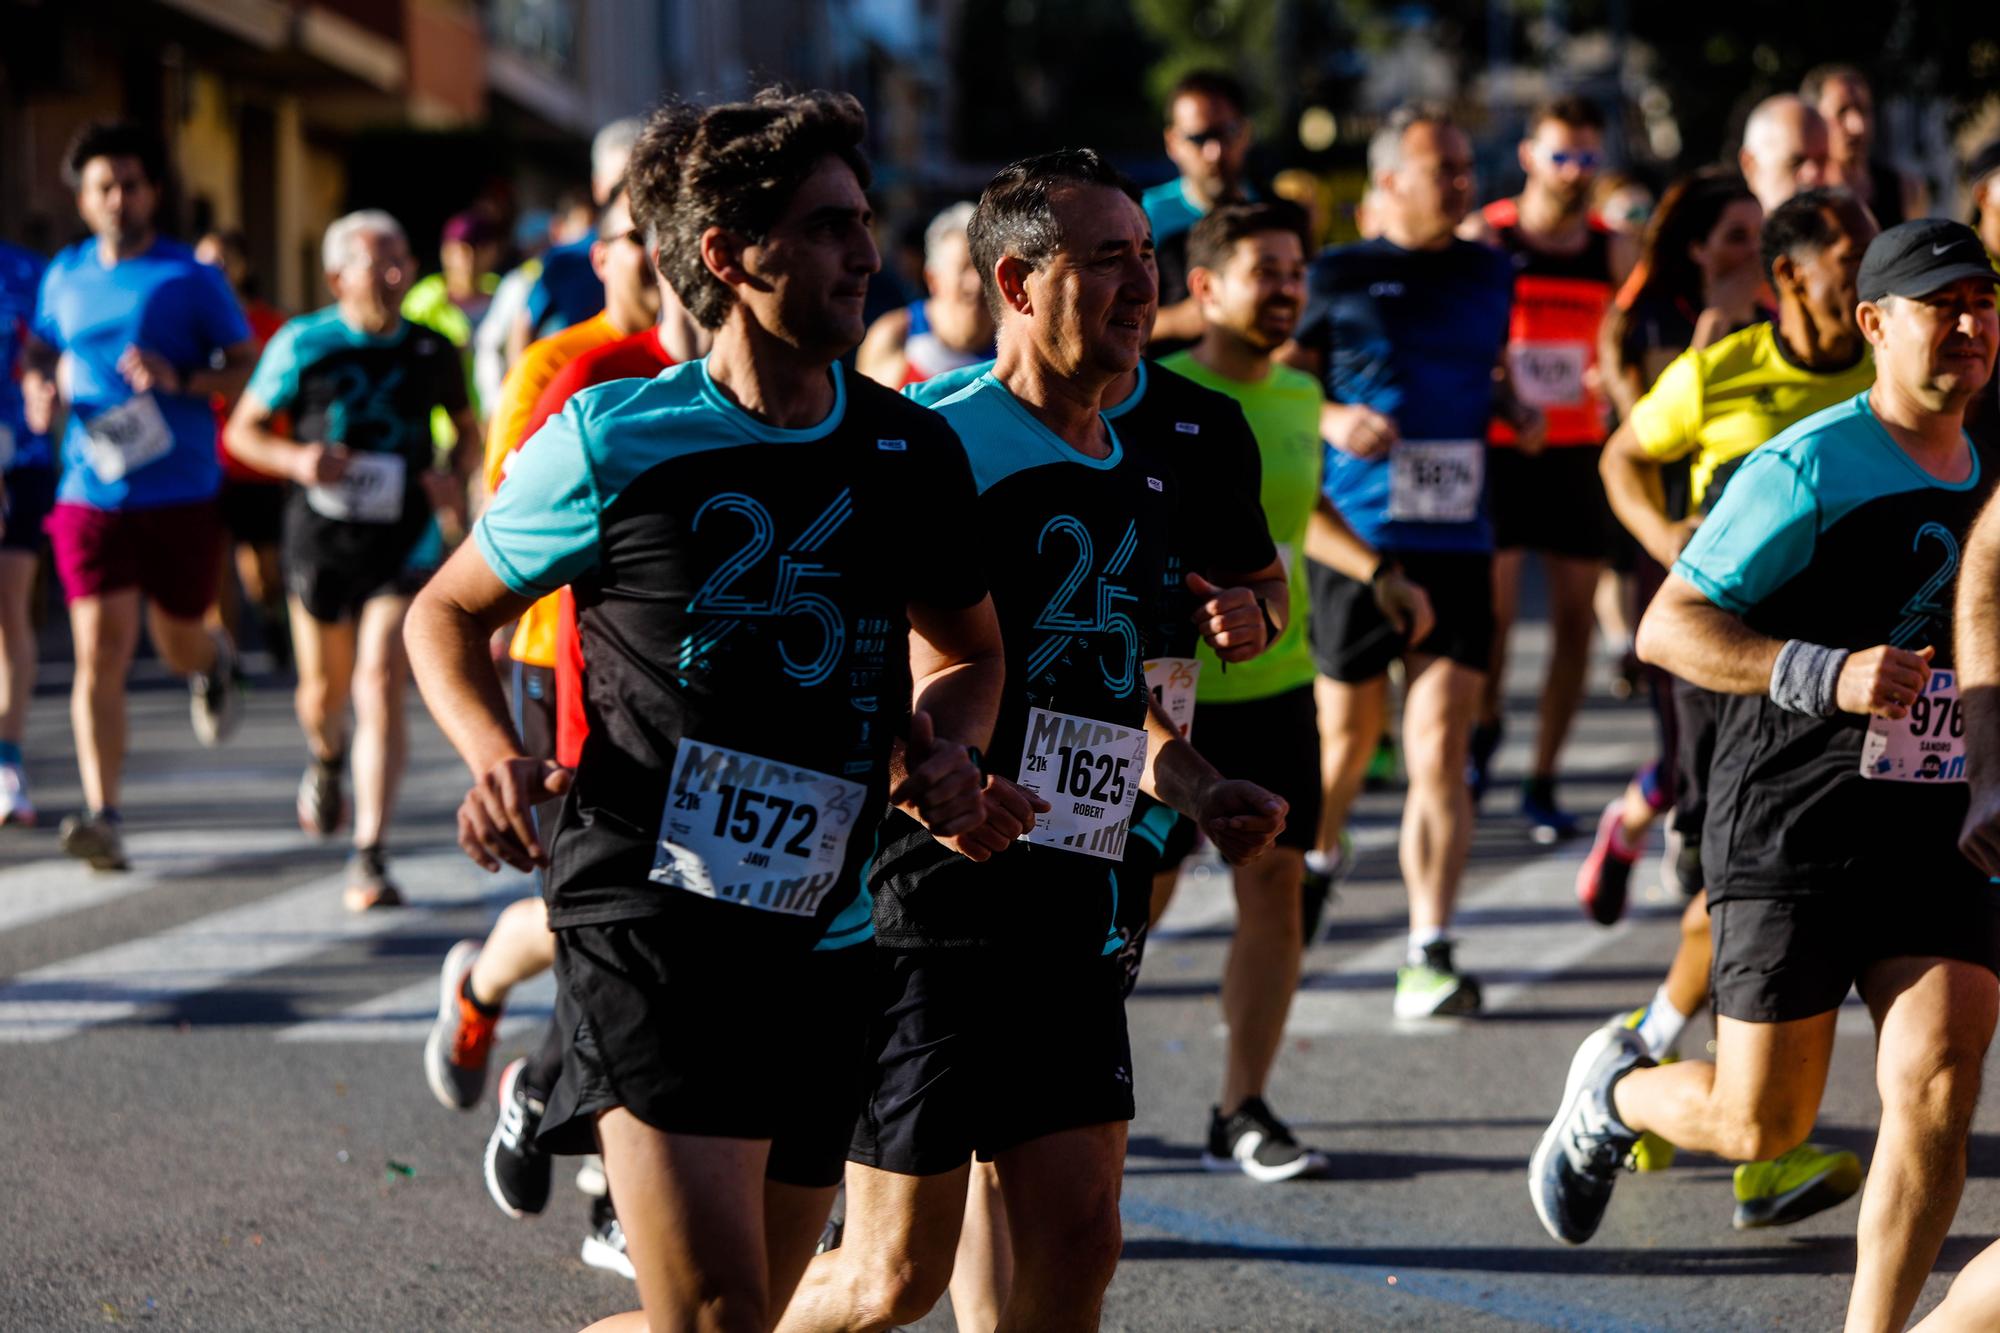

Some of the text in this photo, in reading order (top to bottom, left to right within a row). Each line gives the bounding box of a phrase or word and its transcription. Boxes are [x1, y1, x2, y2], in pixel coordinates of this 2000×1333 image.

[685, 487, 853, 686] 25
[1033, 514, 1138, 698] 25
[1919, 740, 1952, 752] SANDRO
[1055, 746, 1130, 805] 1625
[713, 784, 818, 859] 1572
[821, 783, 863, 826] 25
[1072, 802, 1105, 820] ROBERT
[742, 851, 771, 869] JAVI
